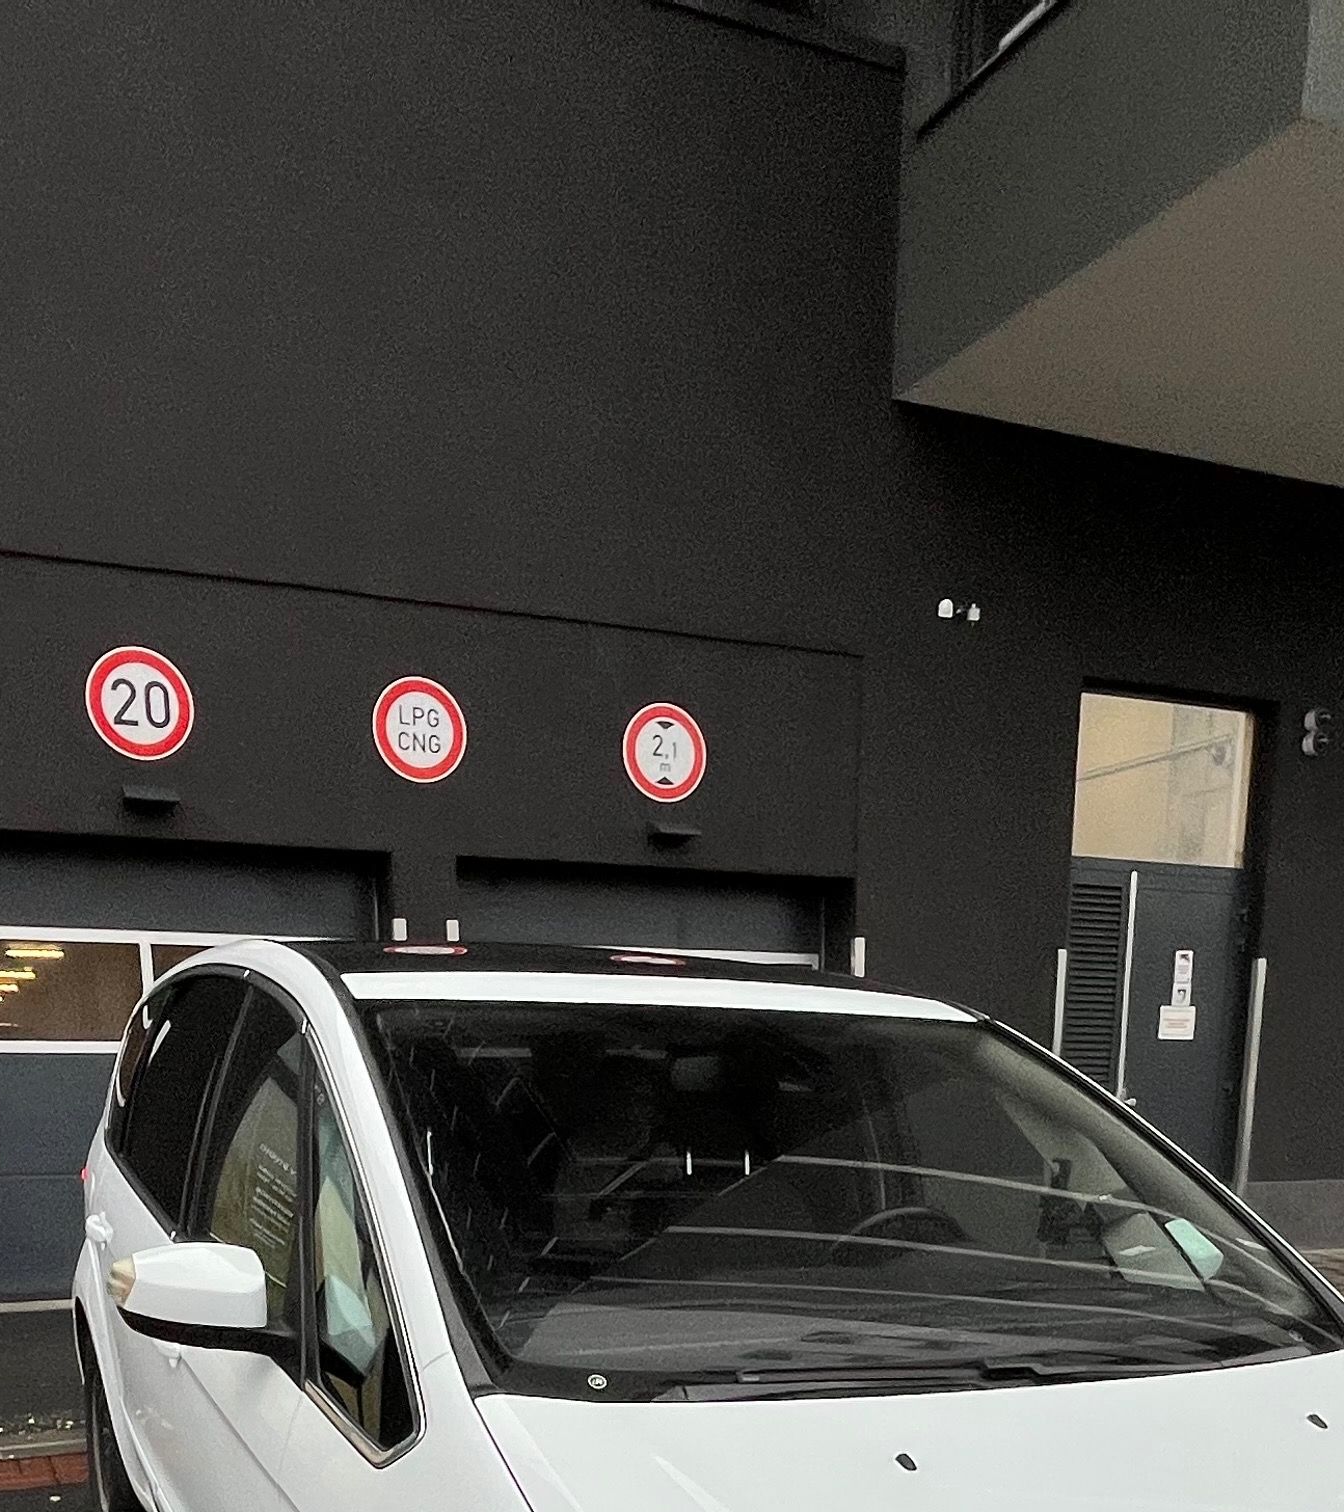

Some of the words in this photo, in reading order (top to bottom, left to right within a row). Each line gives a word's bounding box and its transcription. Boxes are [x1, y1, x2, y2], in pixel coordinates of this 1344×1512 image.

[111, 678, 170, 728] 20
[399, 704, 439, 727] LPG
[398, 732, 441, 753] CNG
[659, 762, 671, 772] m
